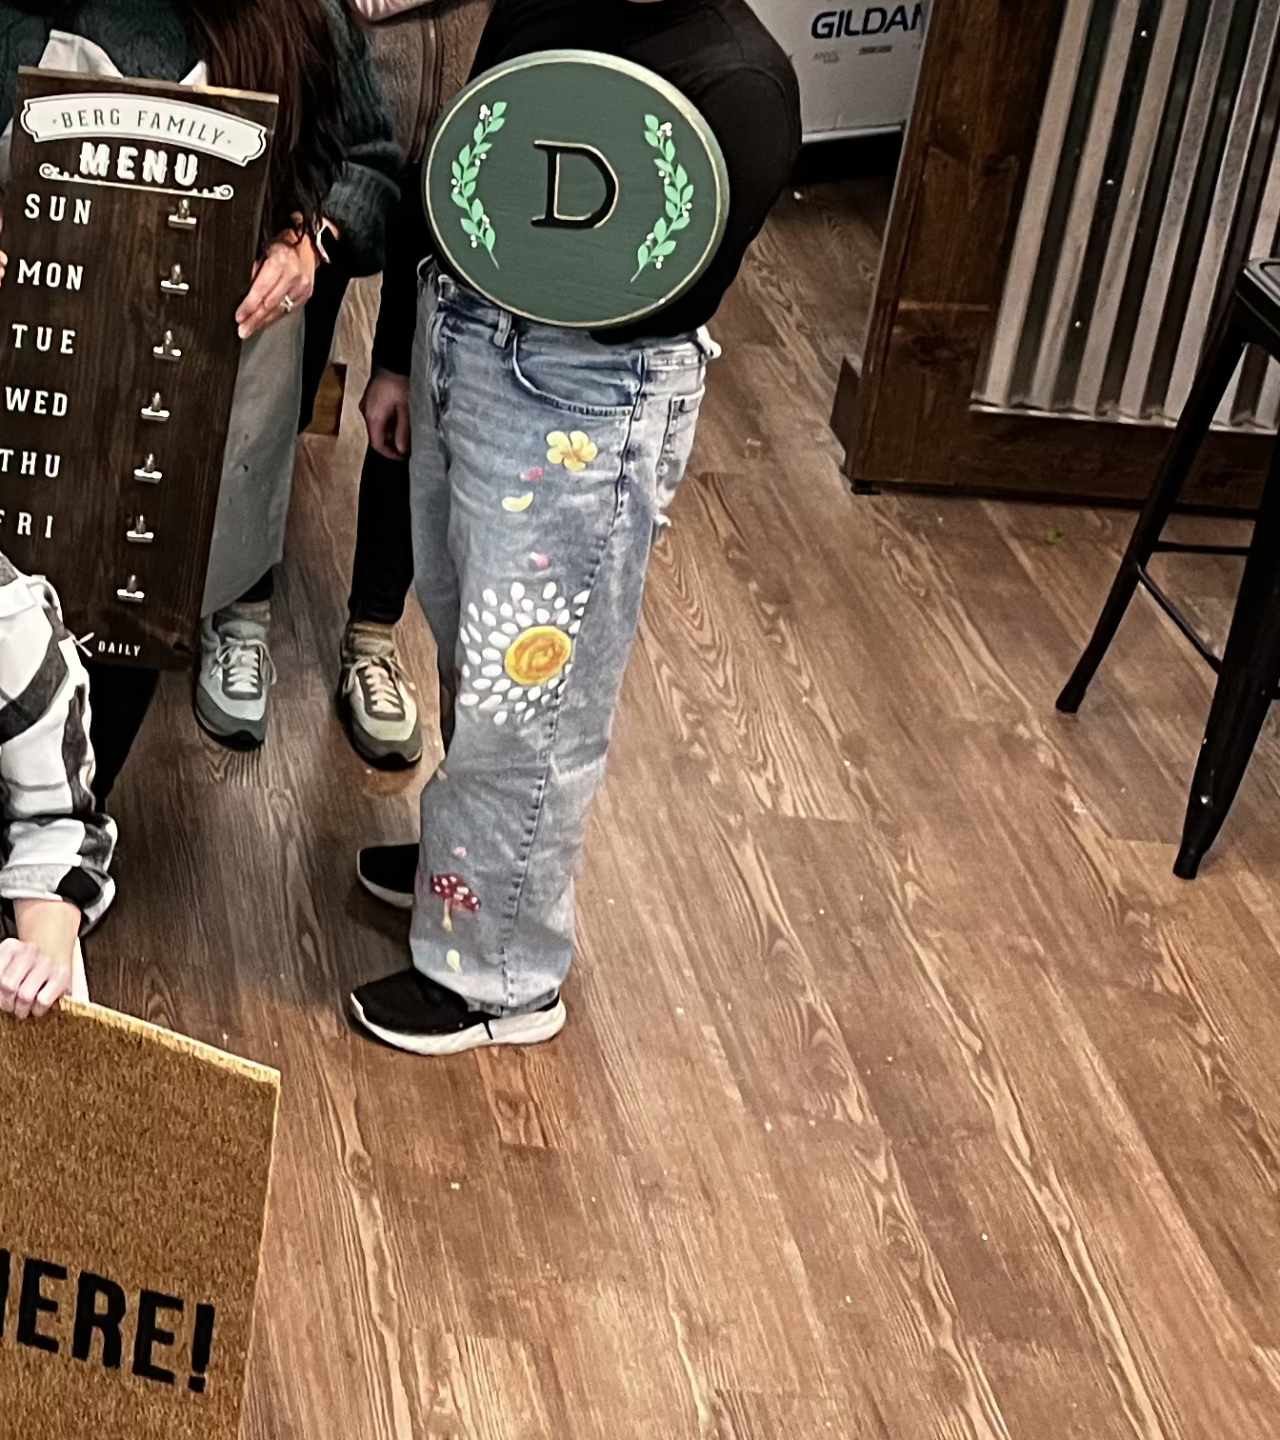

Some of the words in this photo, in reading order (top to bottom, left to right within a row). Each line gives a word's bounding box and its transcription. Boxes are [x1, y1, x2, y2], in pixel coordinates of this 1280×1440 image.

[61, 107, 122, 129] BERG
[137, 110, 226, 146] FAMILY
[79, 141, 200, 187] MENU
[530, 139, 620, 230] D
[24, 193, 93, 226] SUN
[17, 259, 85, 292] MON
[11, 323, 77, 355] TUE
[4, 385, 70, 418] WED
[97, 640, 142, 658] DAILY
